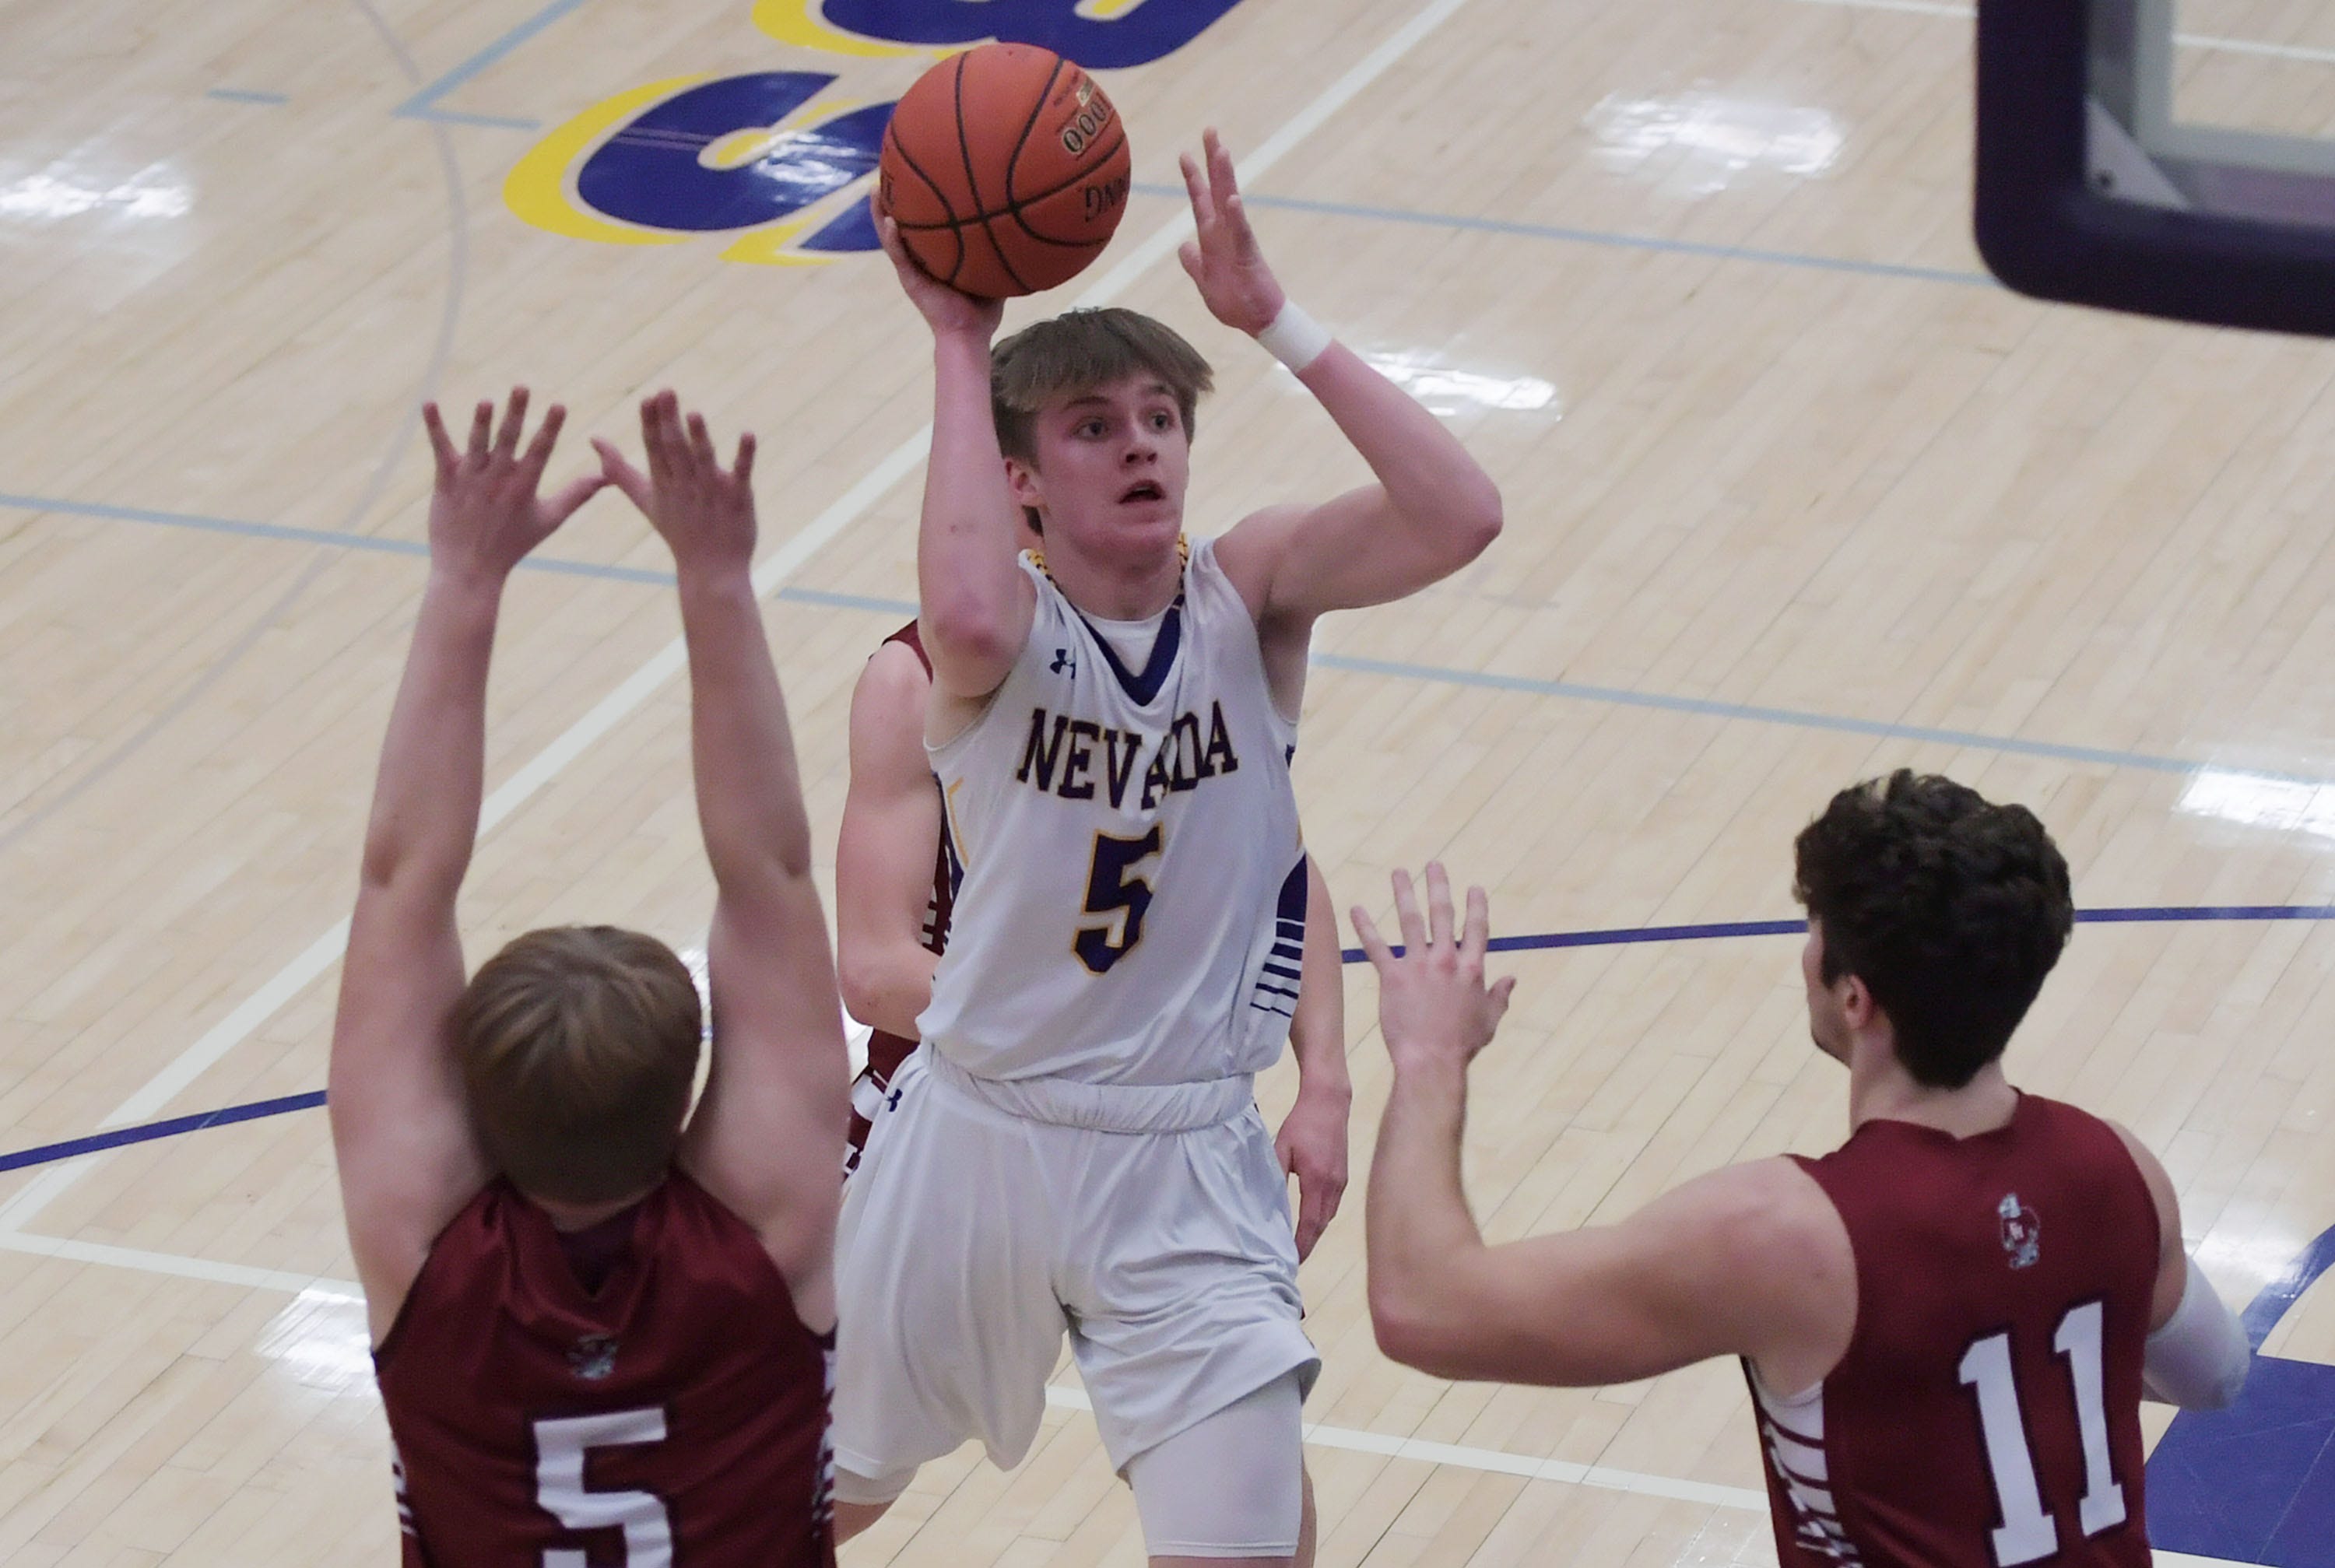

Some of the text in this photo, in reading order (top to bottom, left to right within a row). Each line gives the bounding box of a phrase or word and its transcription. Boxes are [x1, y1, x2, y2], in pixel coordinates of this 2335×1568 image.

[1017, 699, 1239, 811] NEVADA
[1072, 821, 1164, 976] 5
[533, 1407, 673, 1568] 5
[1958, 1300, 2126, 1568] 11
